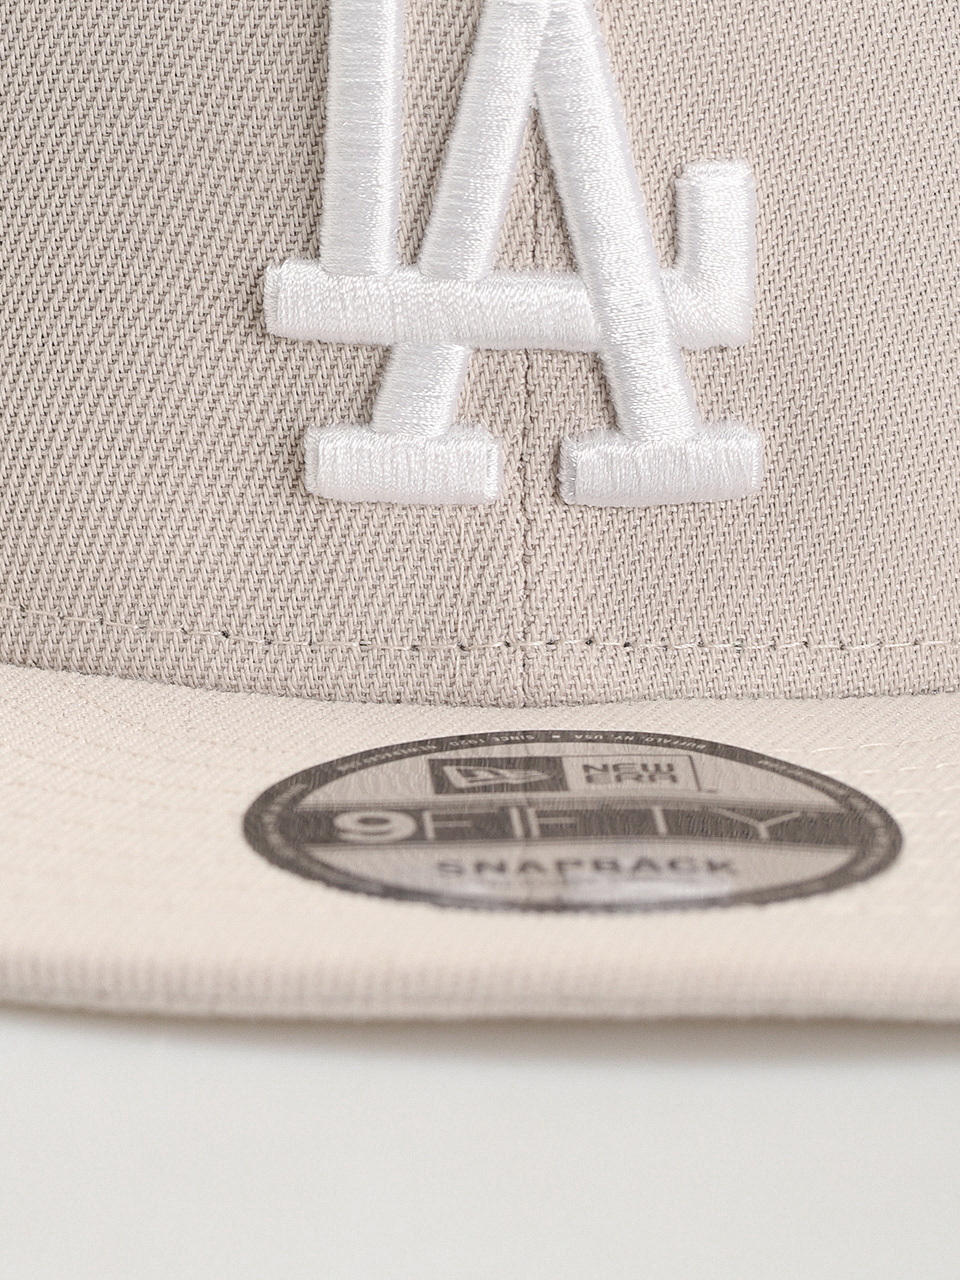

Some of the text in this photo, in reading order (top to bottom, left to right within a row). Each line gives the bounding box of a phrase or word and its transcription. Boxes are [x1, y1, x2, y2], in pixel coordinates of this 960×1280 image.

[583, 763, 674, 773] NEW
[585, 773, 680, 785] ERA
[333, 805, 802, 844] 9FIFTY
[437, 856, 737, 876] SNAPBACK
